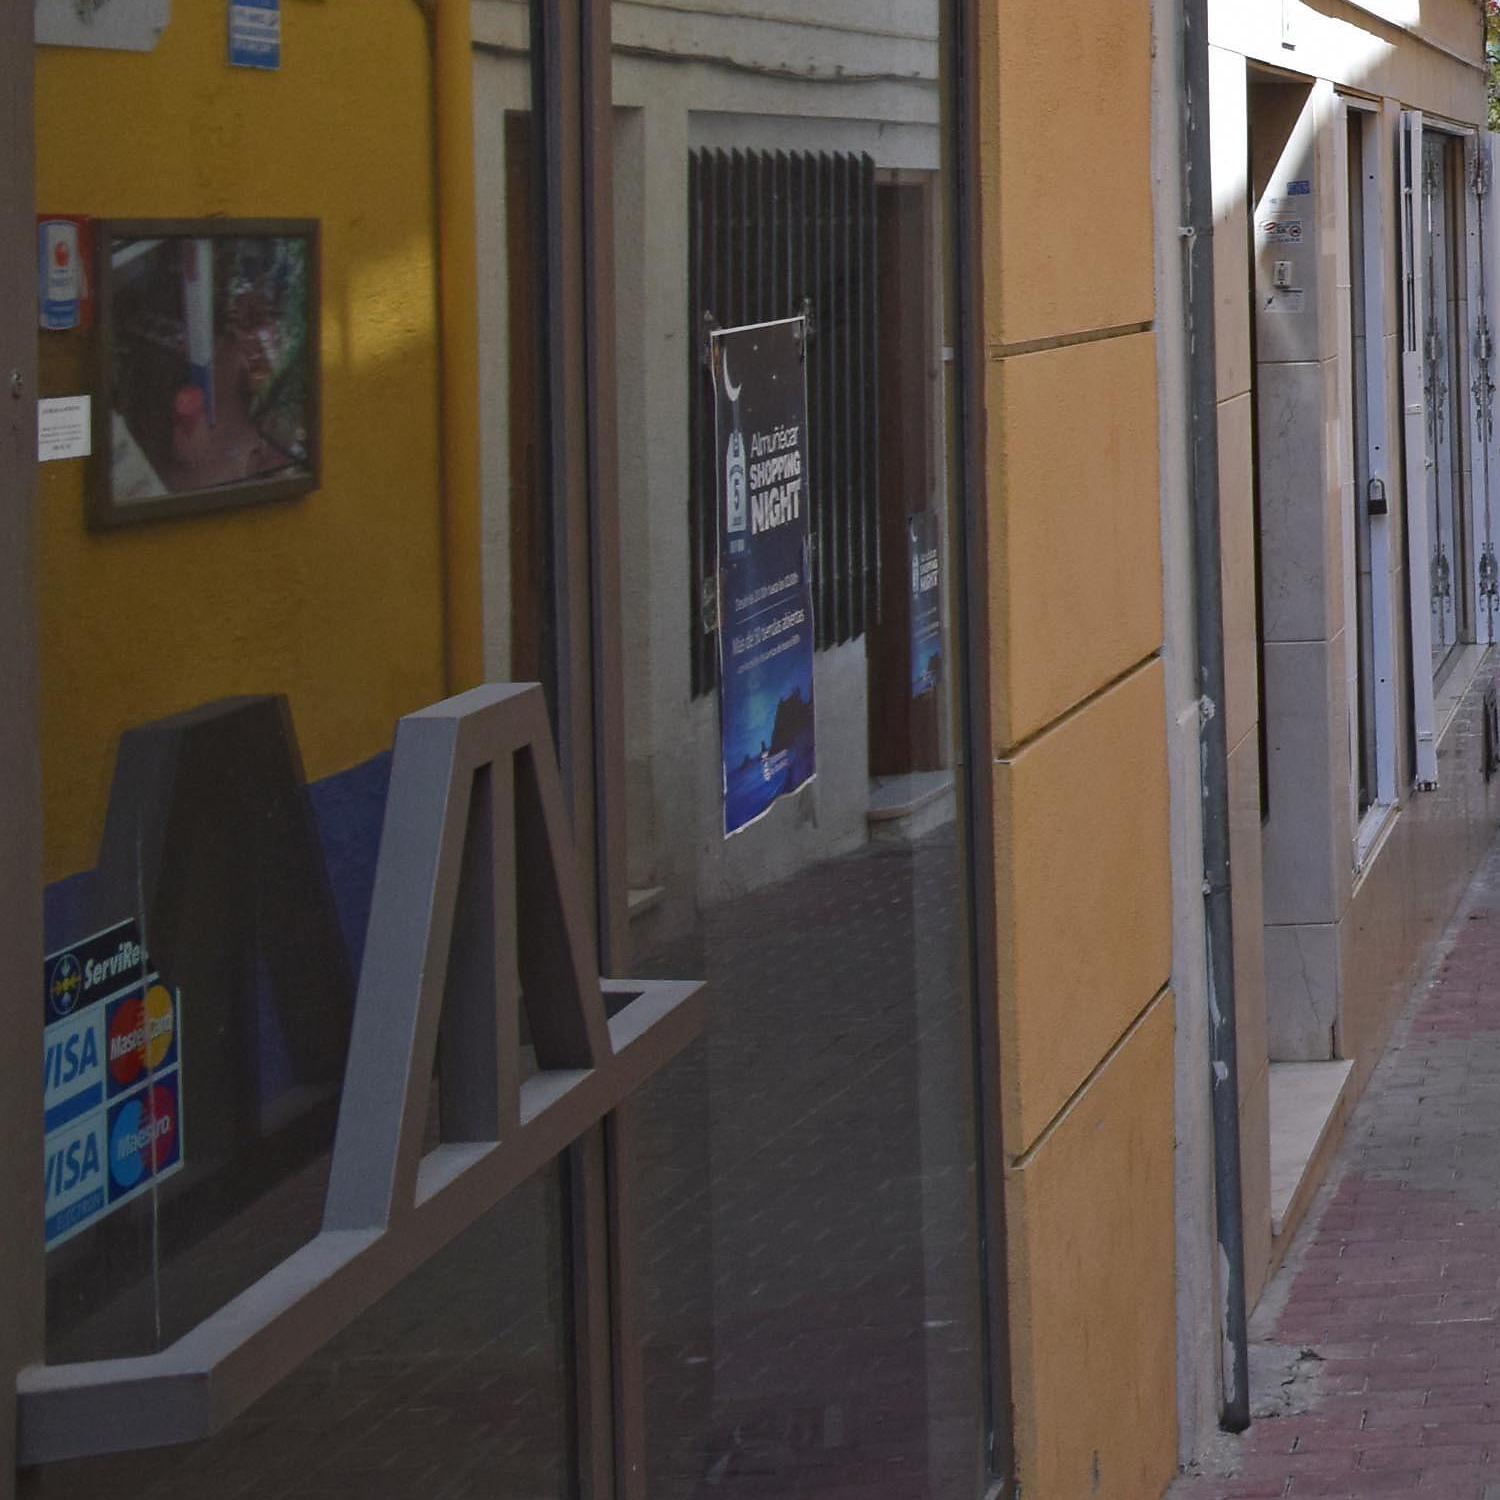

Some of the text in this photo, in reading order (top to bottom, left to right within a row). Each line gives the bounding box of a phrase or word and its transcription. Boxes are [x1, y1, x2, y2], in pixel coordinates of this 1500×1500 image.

[750, 424, 799, 458] Almuñécar
[750, 450, 800, 490] SHOPPING
[751, 479, 801, 535] NIGHT
